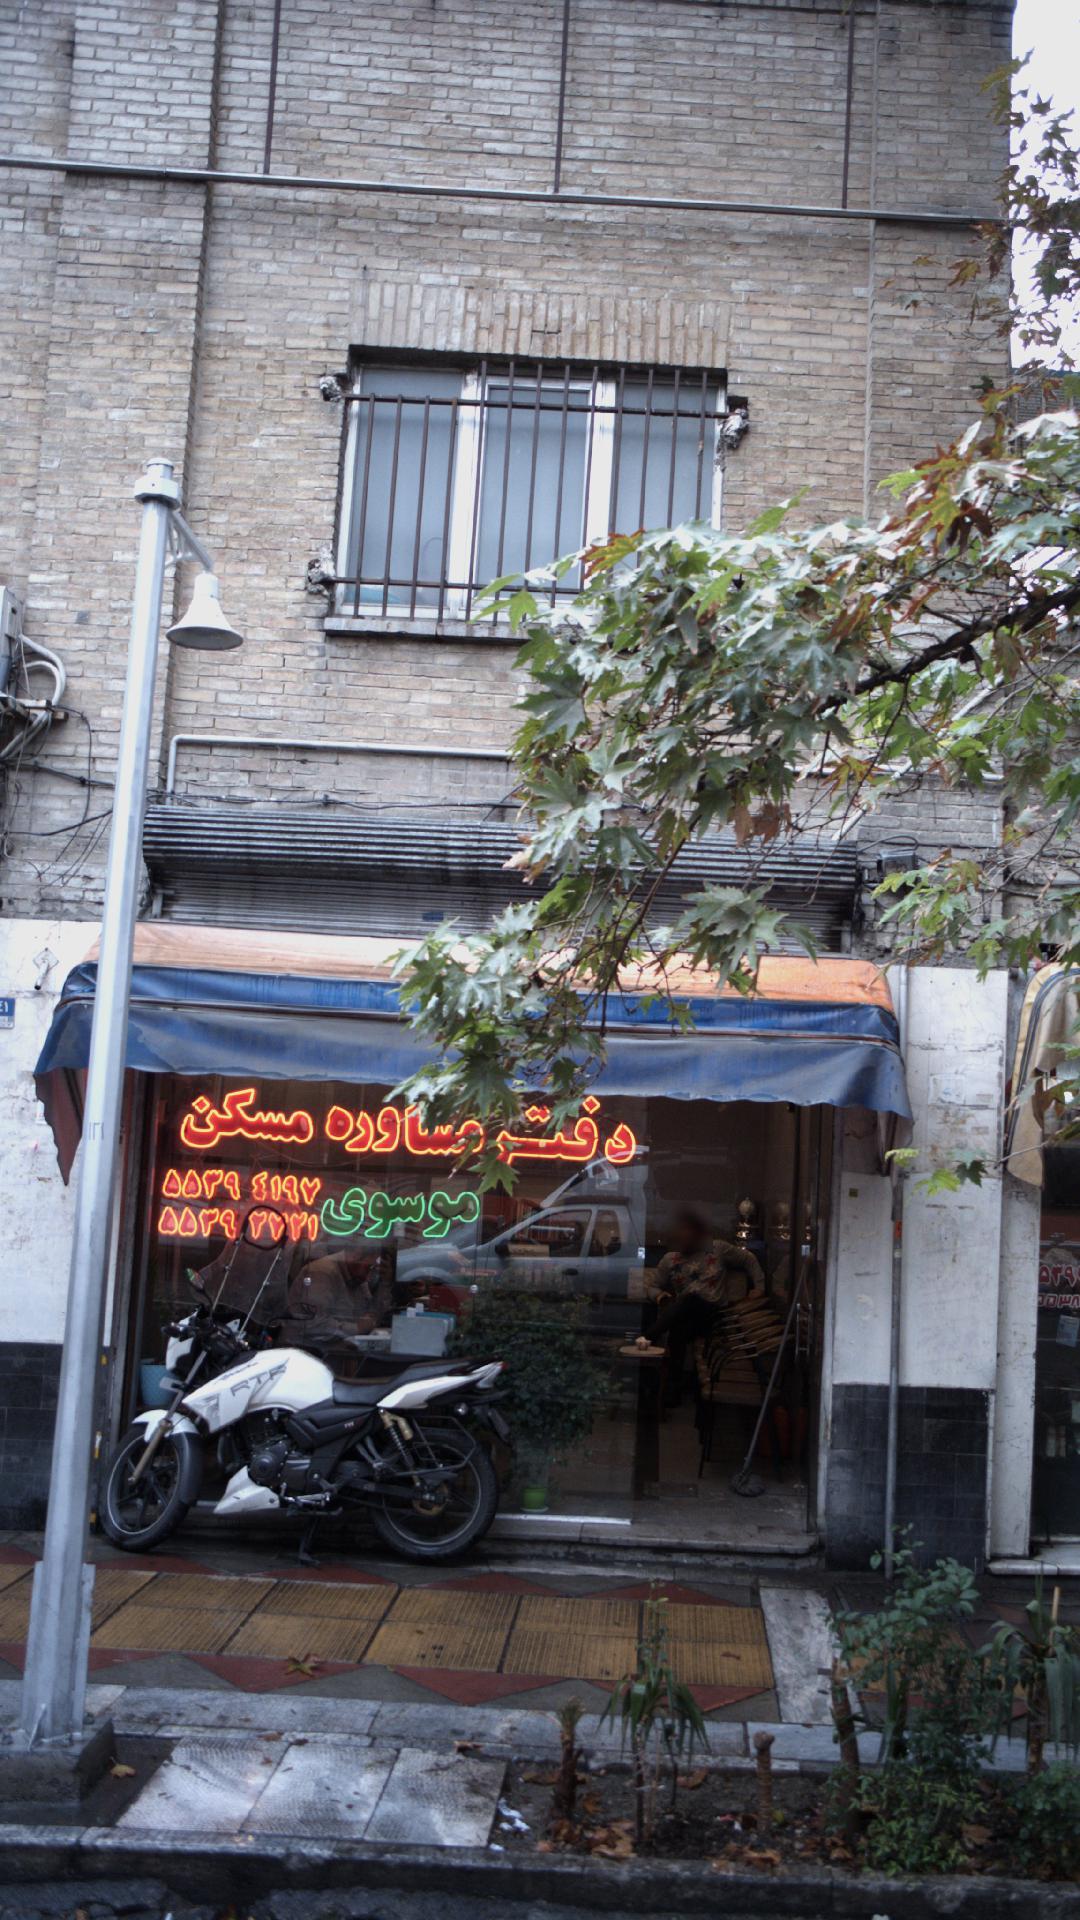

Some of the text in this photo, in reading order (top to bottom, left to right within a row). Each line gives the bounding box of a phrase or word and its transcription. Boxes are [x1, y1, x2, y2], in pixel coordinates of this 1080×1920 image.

[180, 1087, 314, 1149] مسکن
[321, 1187, 481, 1239] موسوی
[229, 1362, 286, 1397] RTR
